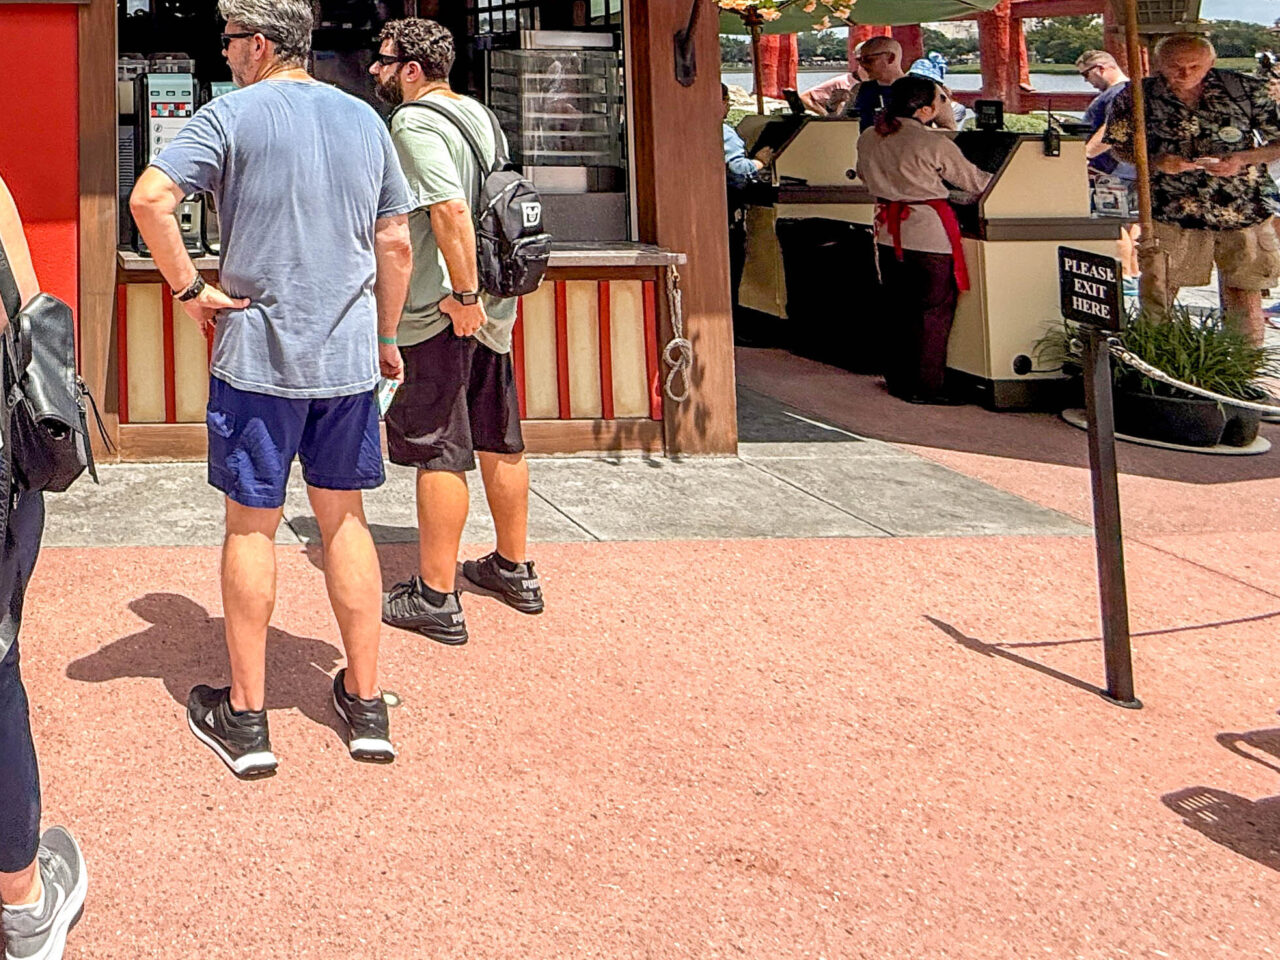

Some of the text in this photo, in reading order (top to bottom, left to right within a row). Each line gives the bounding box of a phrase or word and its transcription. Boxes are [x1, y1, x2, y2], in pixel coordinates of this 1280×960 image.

[1064, 257, 1116, 283] PLEASE
[1074, 278, 1107, 299] EXIT
[1072, 296, 1111, 320] HERE
